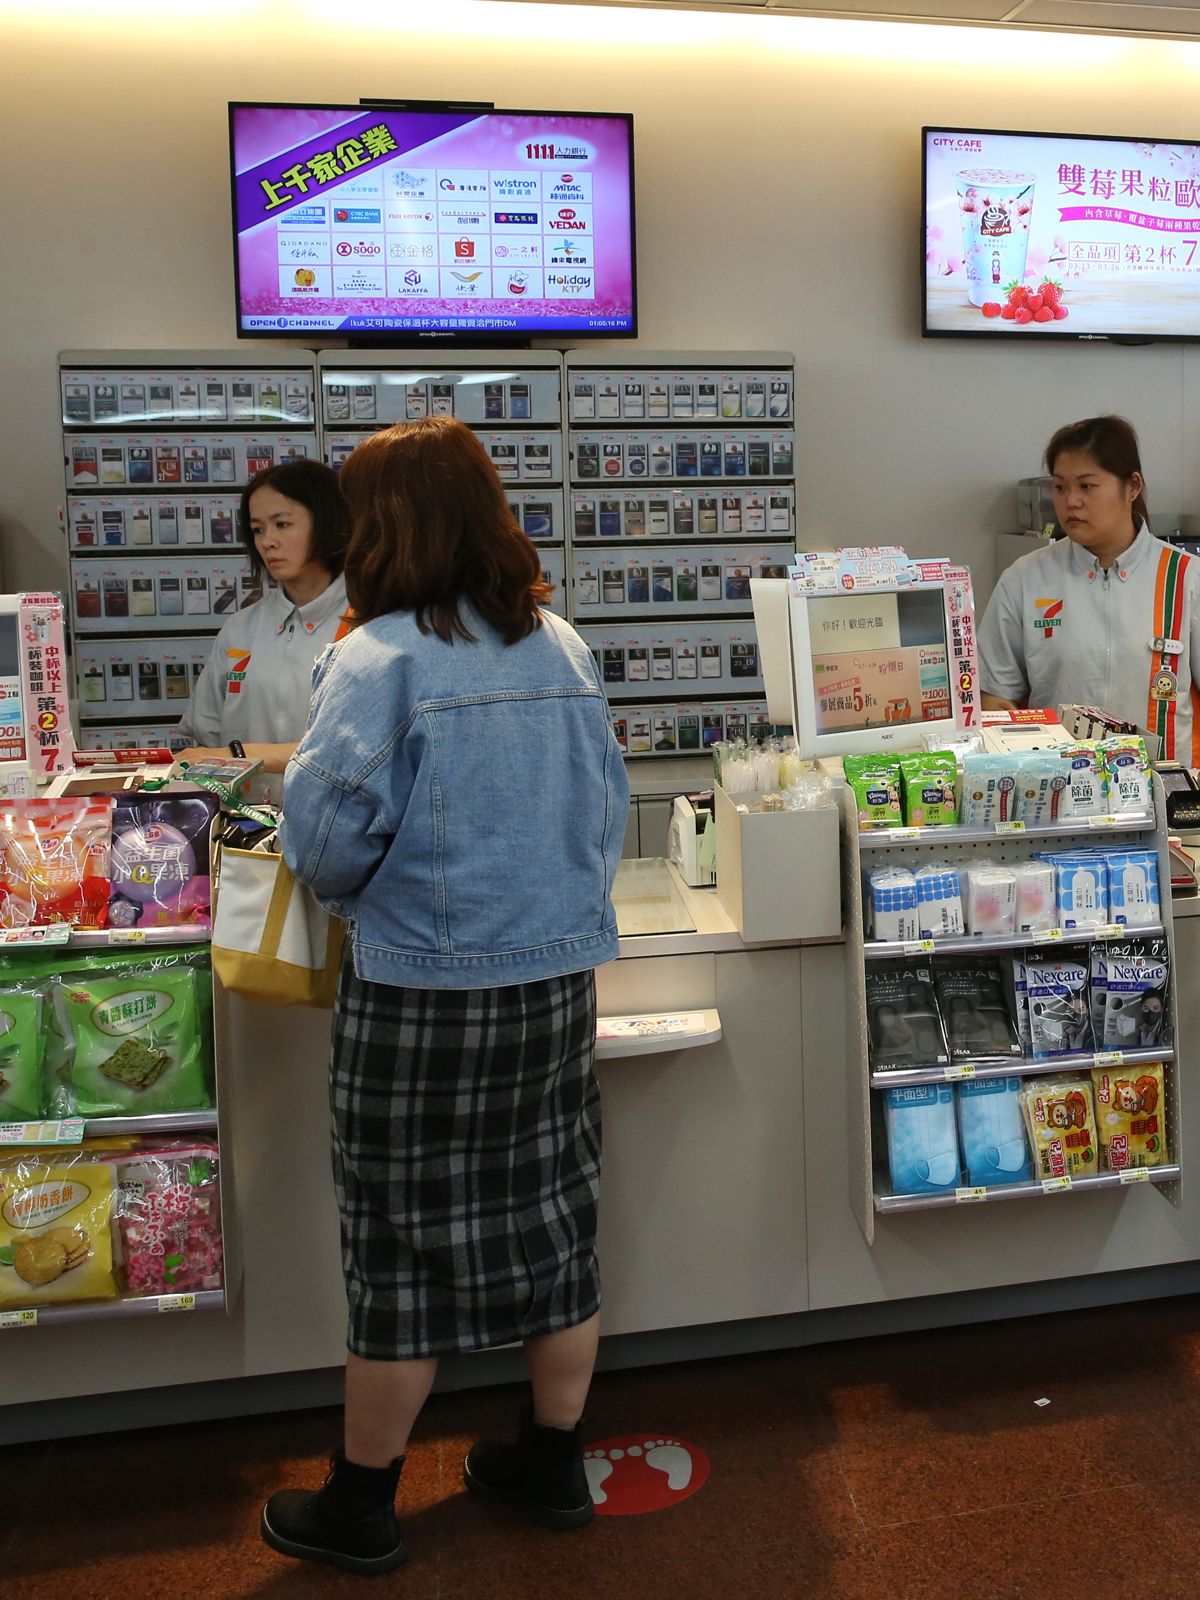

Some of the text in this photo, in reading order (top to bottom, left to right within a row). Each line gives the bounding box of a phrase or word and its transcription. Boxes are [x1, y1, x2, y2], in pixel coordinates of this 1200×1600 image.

[933, 138, 982, 148] CITY CAFE
[526, 144, 554, 159] 1111
[259, 123, 398, 211] 上千家企業
[494, 180, 536, 188] wistron
[549, 221, 586, 229] VEDAN
[354, 245, 381, 254] SOGO
[1071, 244, 1119, 261] 全品項
[548, 275, 591, 287] Holiday
[562, 285, 584, 293] KTV
[28, 650, 44, 692] 杯裝咖啡
[45, 646, 61, 693] 中杯以上
[1071, 786, 1093, 797] 除菌
[1119, 783, 1139, 795] 除菌
[125, 847, 182, 862] 益生菌
[1033, 970, 1084, 984] Nexcare
[1114, 964, 1162, 982] Nexcare
[98, 994, 156, 1025] 青醬蘇打餅
[892, 1088, 928, 1101] 平面型
[1109, 1133, 1129, 1171] 暖包
[21, 1312, 34, 1320] 120
